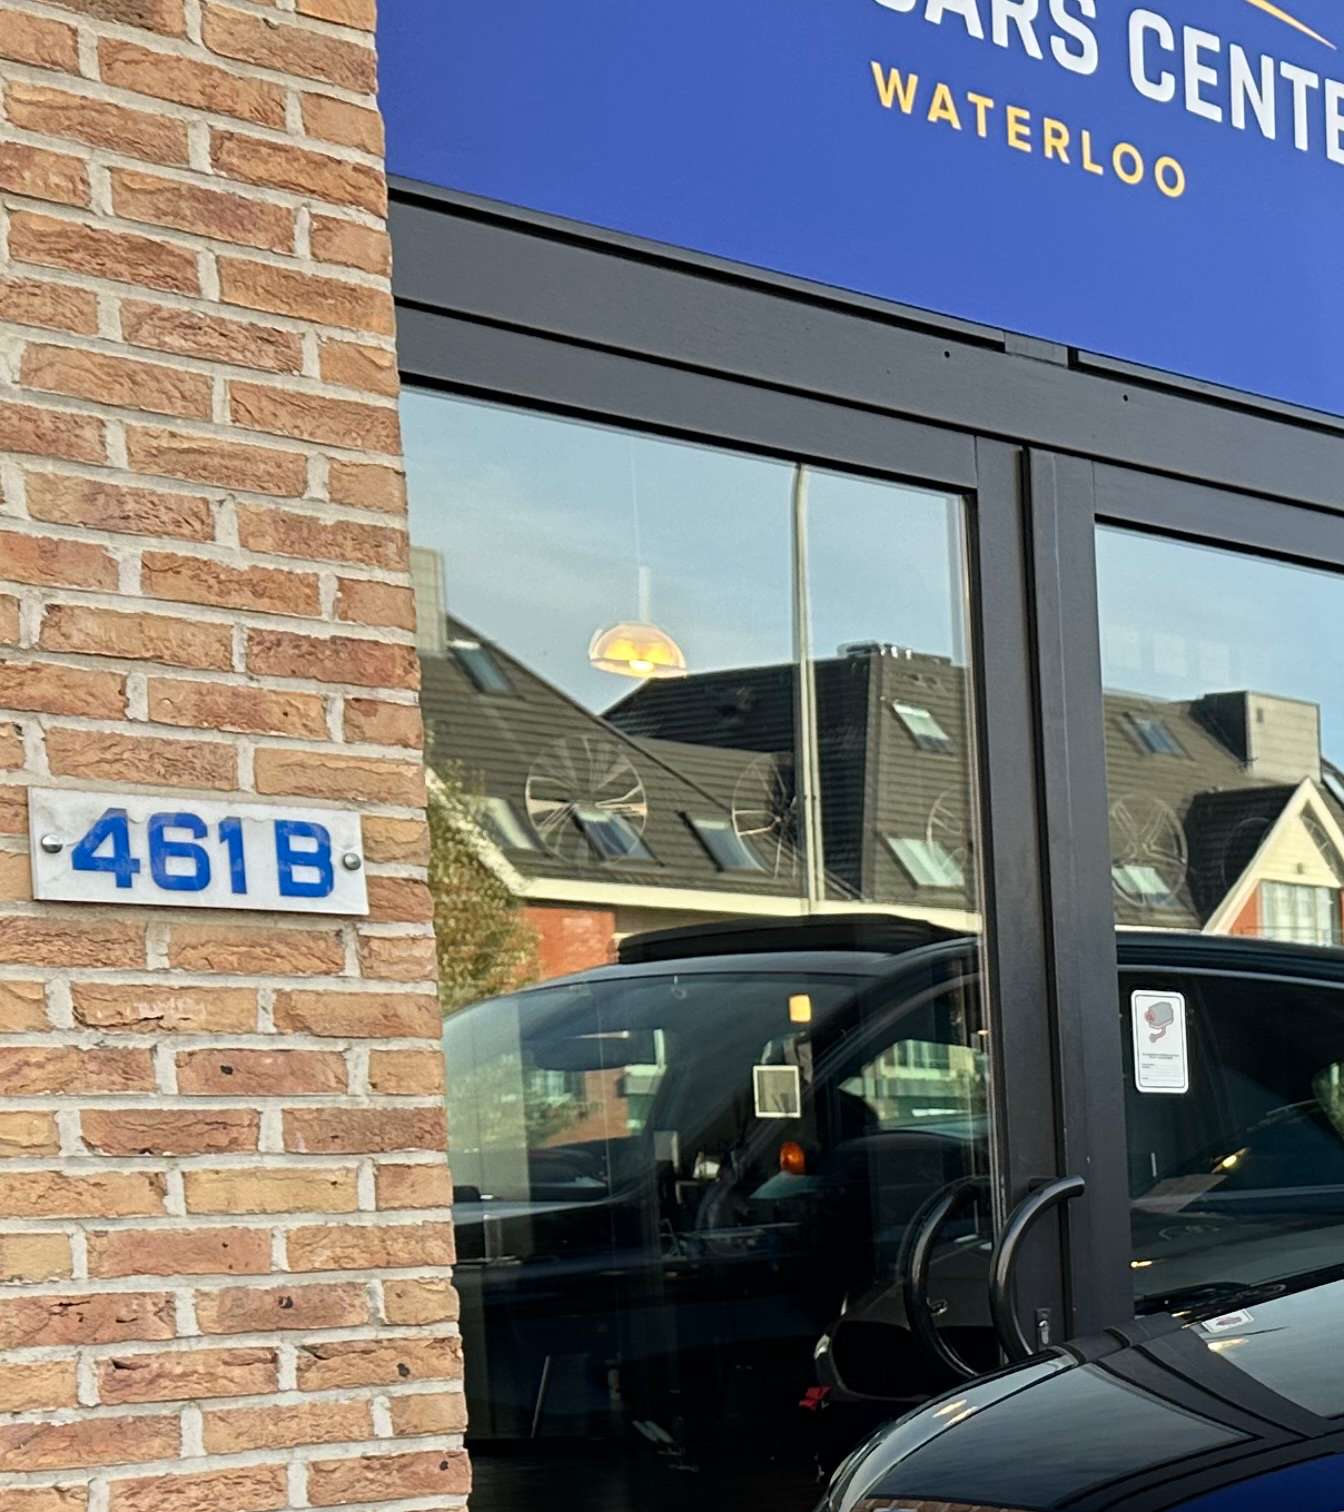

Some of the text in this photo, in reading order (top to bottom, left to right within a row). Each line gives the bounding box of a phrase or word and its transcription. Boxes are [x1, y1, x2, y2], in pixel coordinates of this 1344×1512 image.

[870, 60, 1186, 198] WATERLOO
[71, 807, 335, 898] 461 B
